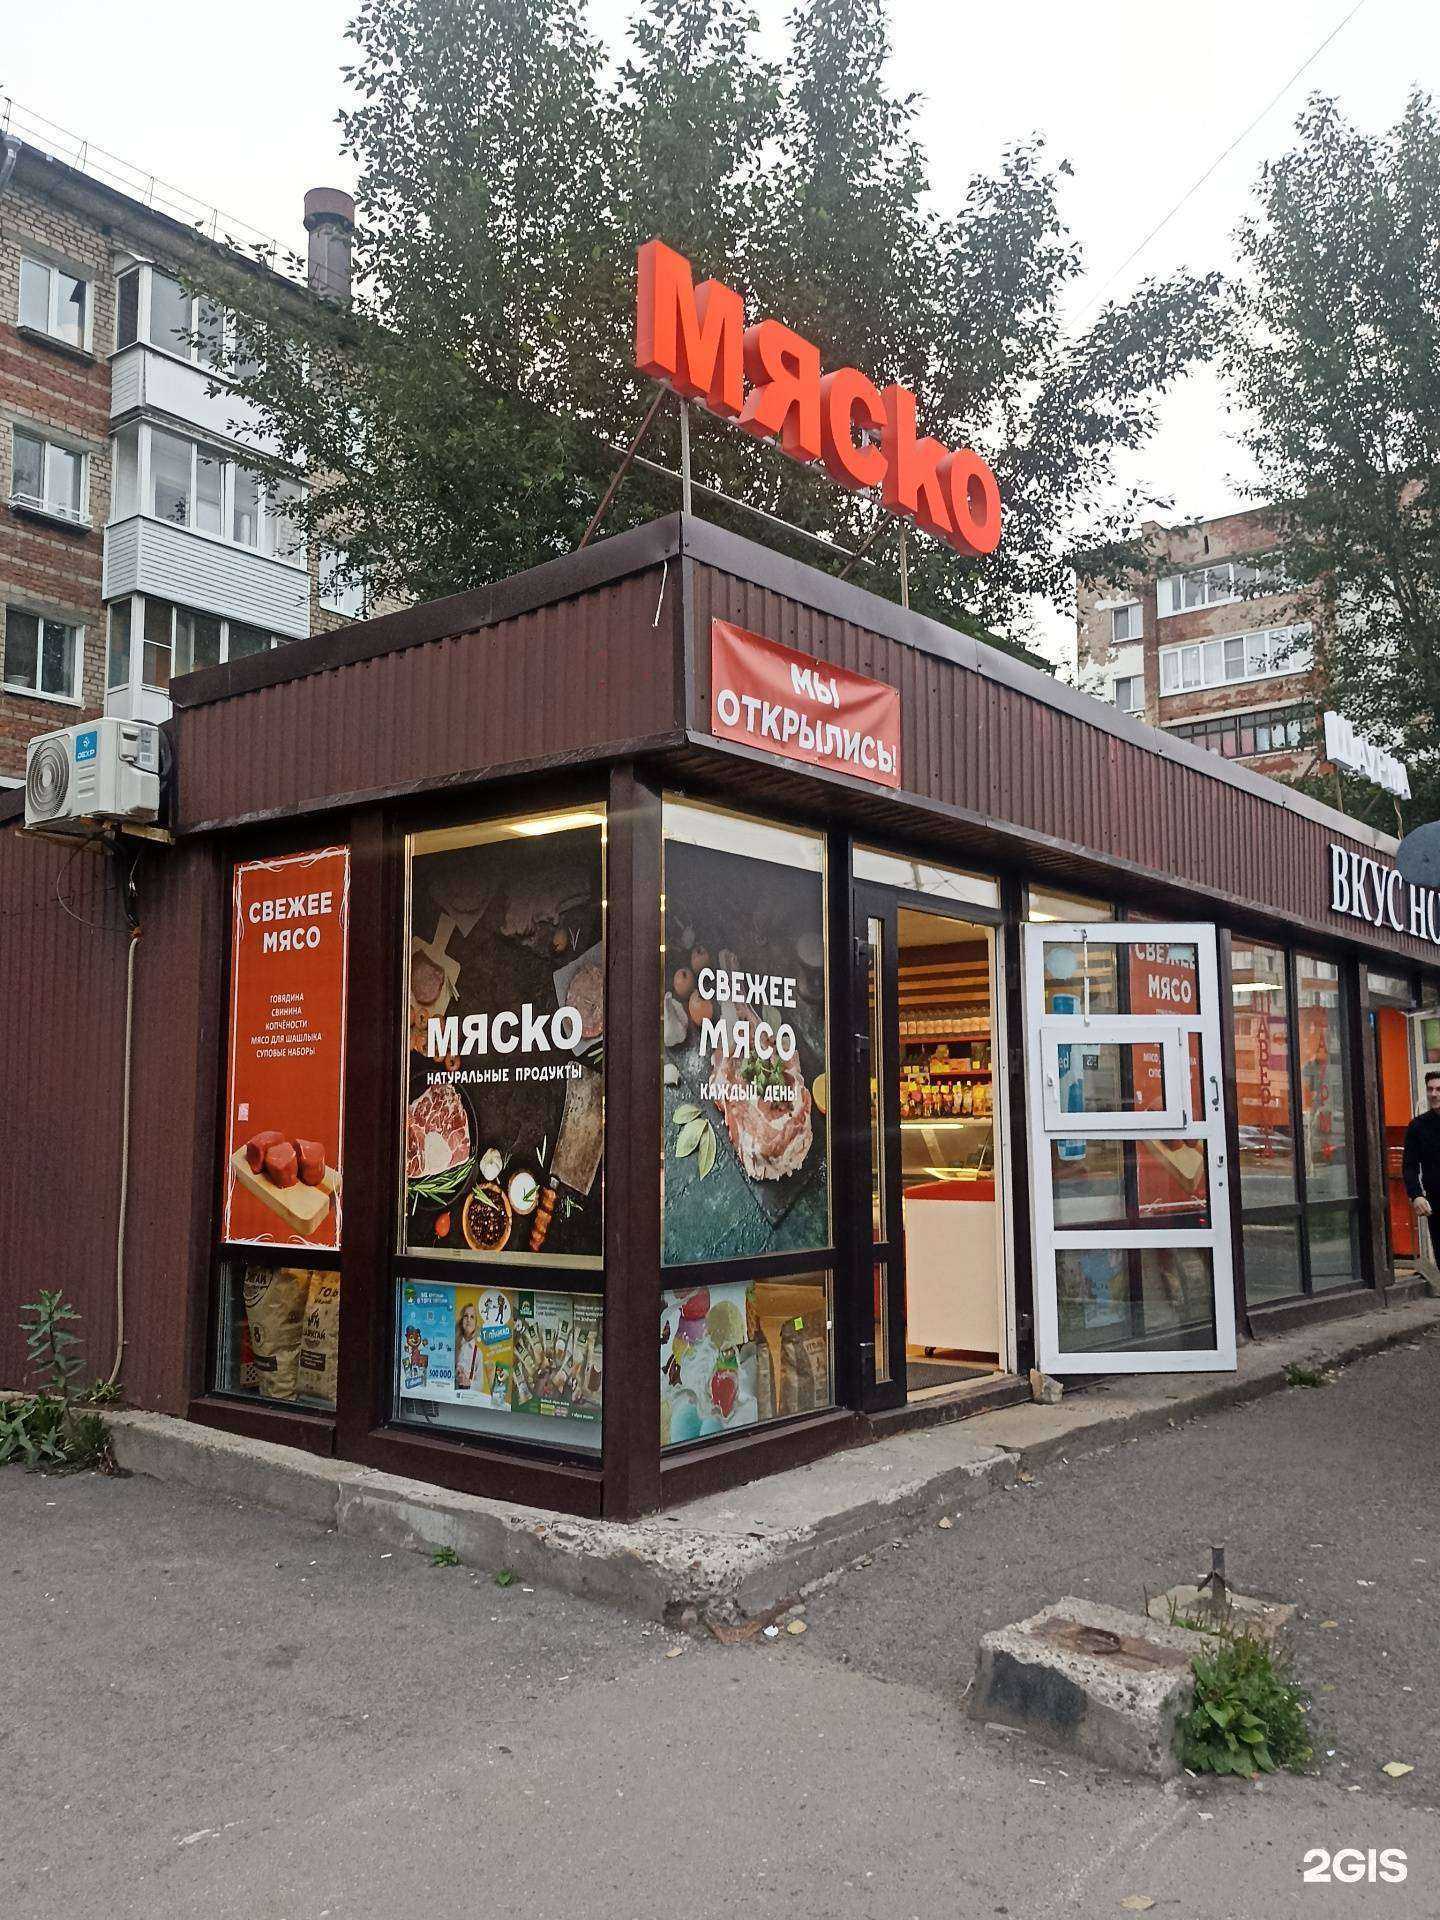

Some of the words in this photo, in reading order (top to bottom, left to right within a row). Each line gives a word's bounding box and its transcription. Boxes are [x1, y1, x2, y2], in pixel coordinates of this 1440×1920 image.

[790, 662, 840, 709] МЫ
[717, 688, 897, 776] ОТКРЫЛИСЬ!
[249, 891, 333, 924] СВЕЖЕЕ
[263, 925, 321, 954] МЯСО
[270, 993, 304, 1003] ГОВЯДИНА
[697, 967, 797, 1008] СВЕЖЕЕ
[1148, 974, 1192, 1004] МЯСО
[271, 1006, 302, 1017] СВИНИНА
[251, 1035, 270, 1045] МЯСО
[271, 1034, 285, 1045] ДЛЯ
[286, 1032, 322, 1043] ШАШЛЫКА
[265, 1020, 308, 1031] КОПЧЁНОСТИ
[698, 1017, 797, 1061] МЯСО
[256, 1048, 286, 1058] СУПОВЫЕ
[288, 1046, 316, 1056] НАБОРЫ
[427, 1068, 509, 1085] НАТУРАЛЬНЫЕ
[515, 1065, 583, 1084] ПРОДУКТЫ
[700, 1078, 759, 1102] КАЖДЫЙ
[764, 1084, 798, 1103] ДЕНЬ
